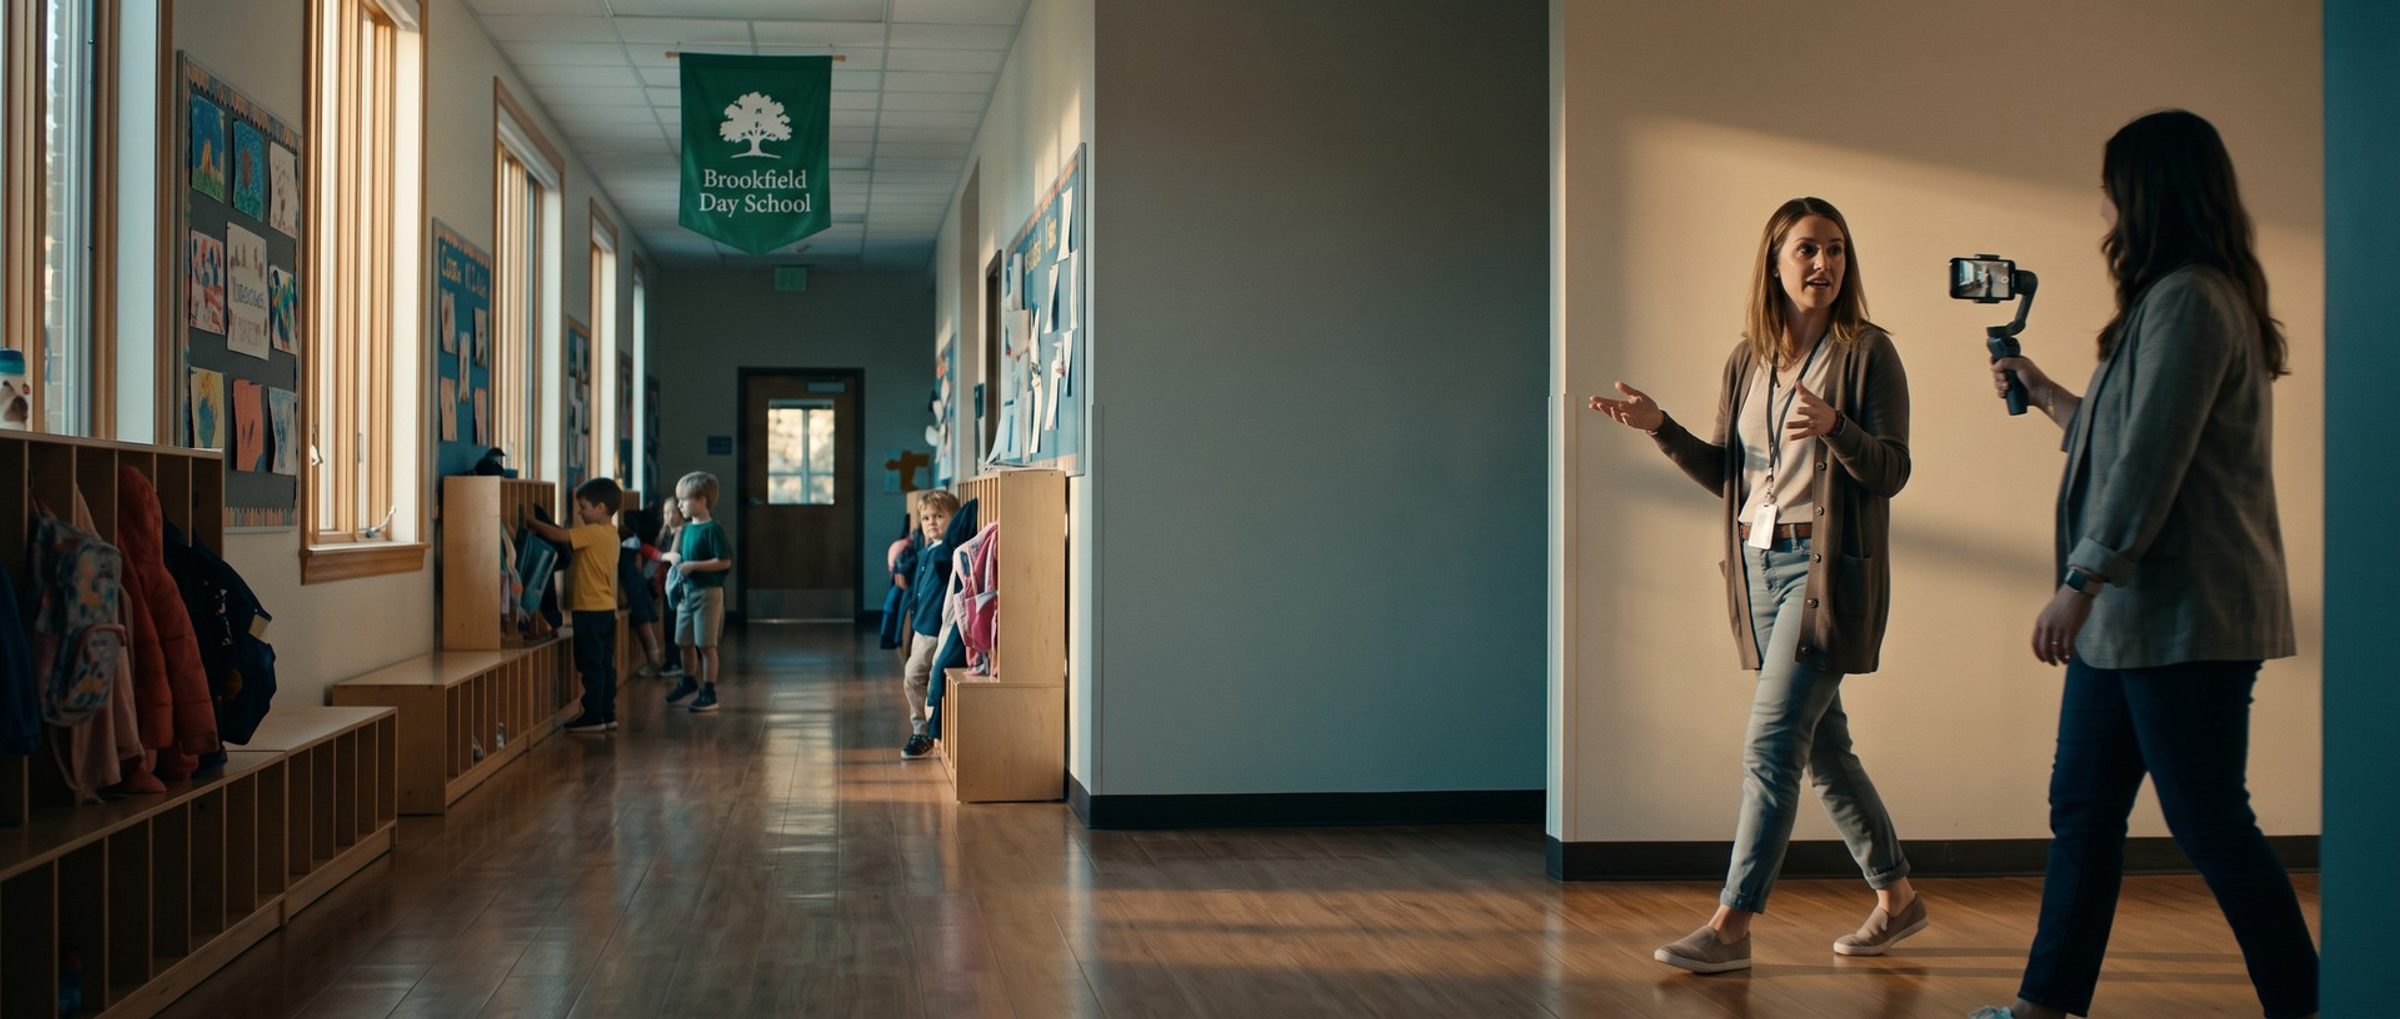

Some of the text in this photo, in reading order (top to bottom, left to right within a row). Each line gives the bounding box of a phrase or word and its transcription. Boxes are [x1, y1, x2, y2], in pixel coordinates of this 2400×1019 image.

[703, 169, 807, 189] Brookfield
[699, 193, 812, 218] Day School
